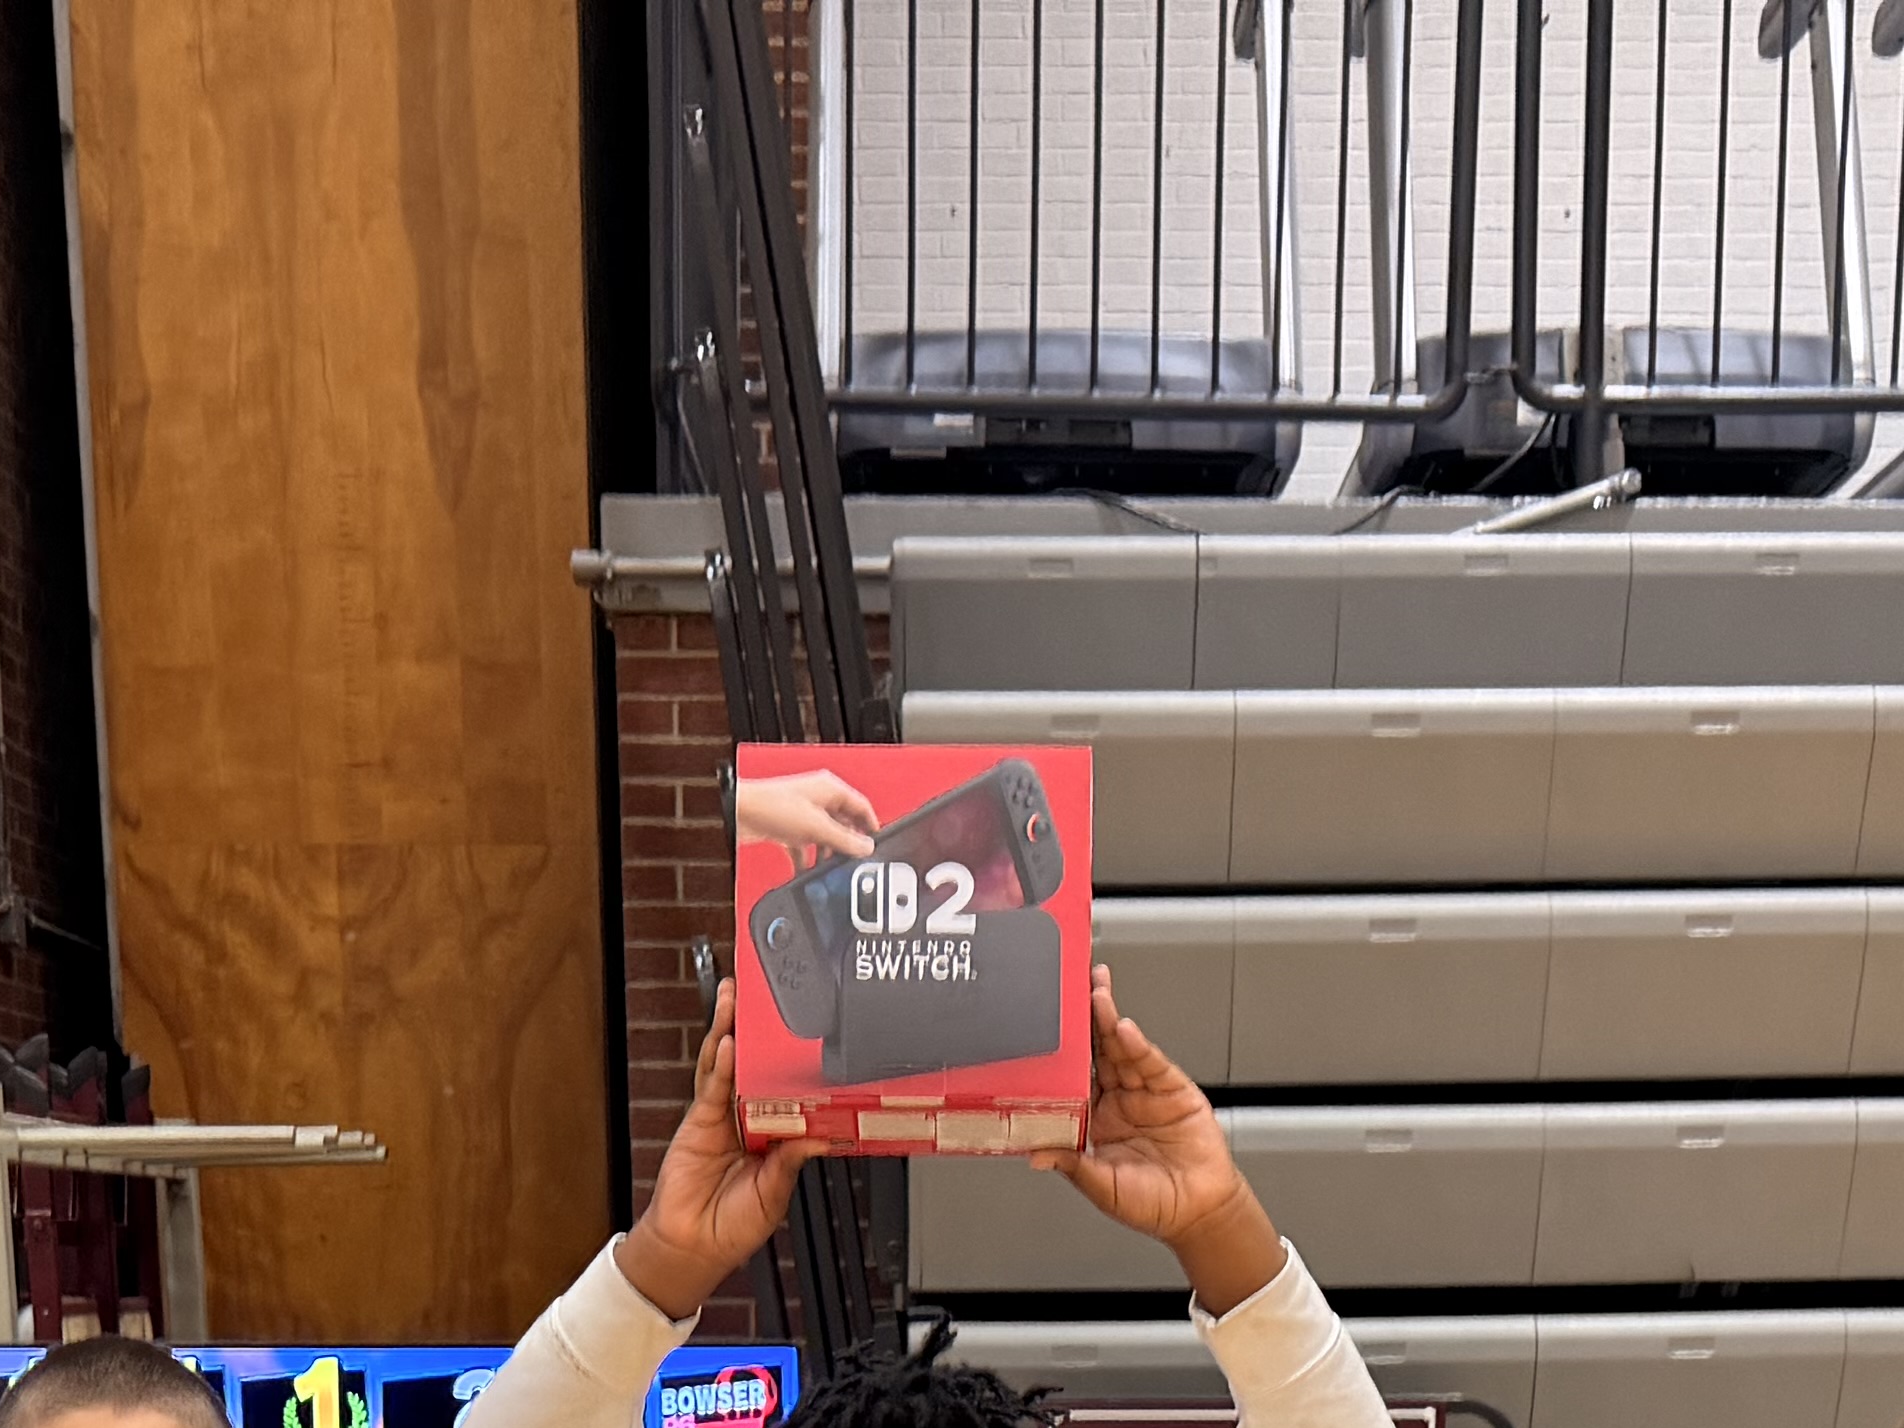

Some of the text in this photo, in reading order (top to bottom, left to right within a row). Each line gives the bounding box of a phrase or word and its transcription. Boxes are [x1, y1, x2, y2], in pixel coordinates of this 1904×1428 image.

[925, 861, 976, 934] 2
[856, 939, 971, 957] NINTENDO
[856, 954, 971, 981] SWITCH
[661, 1380, 766, 1416] BOWSER
